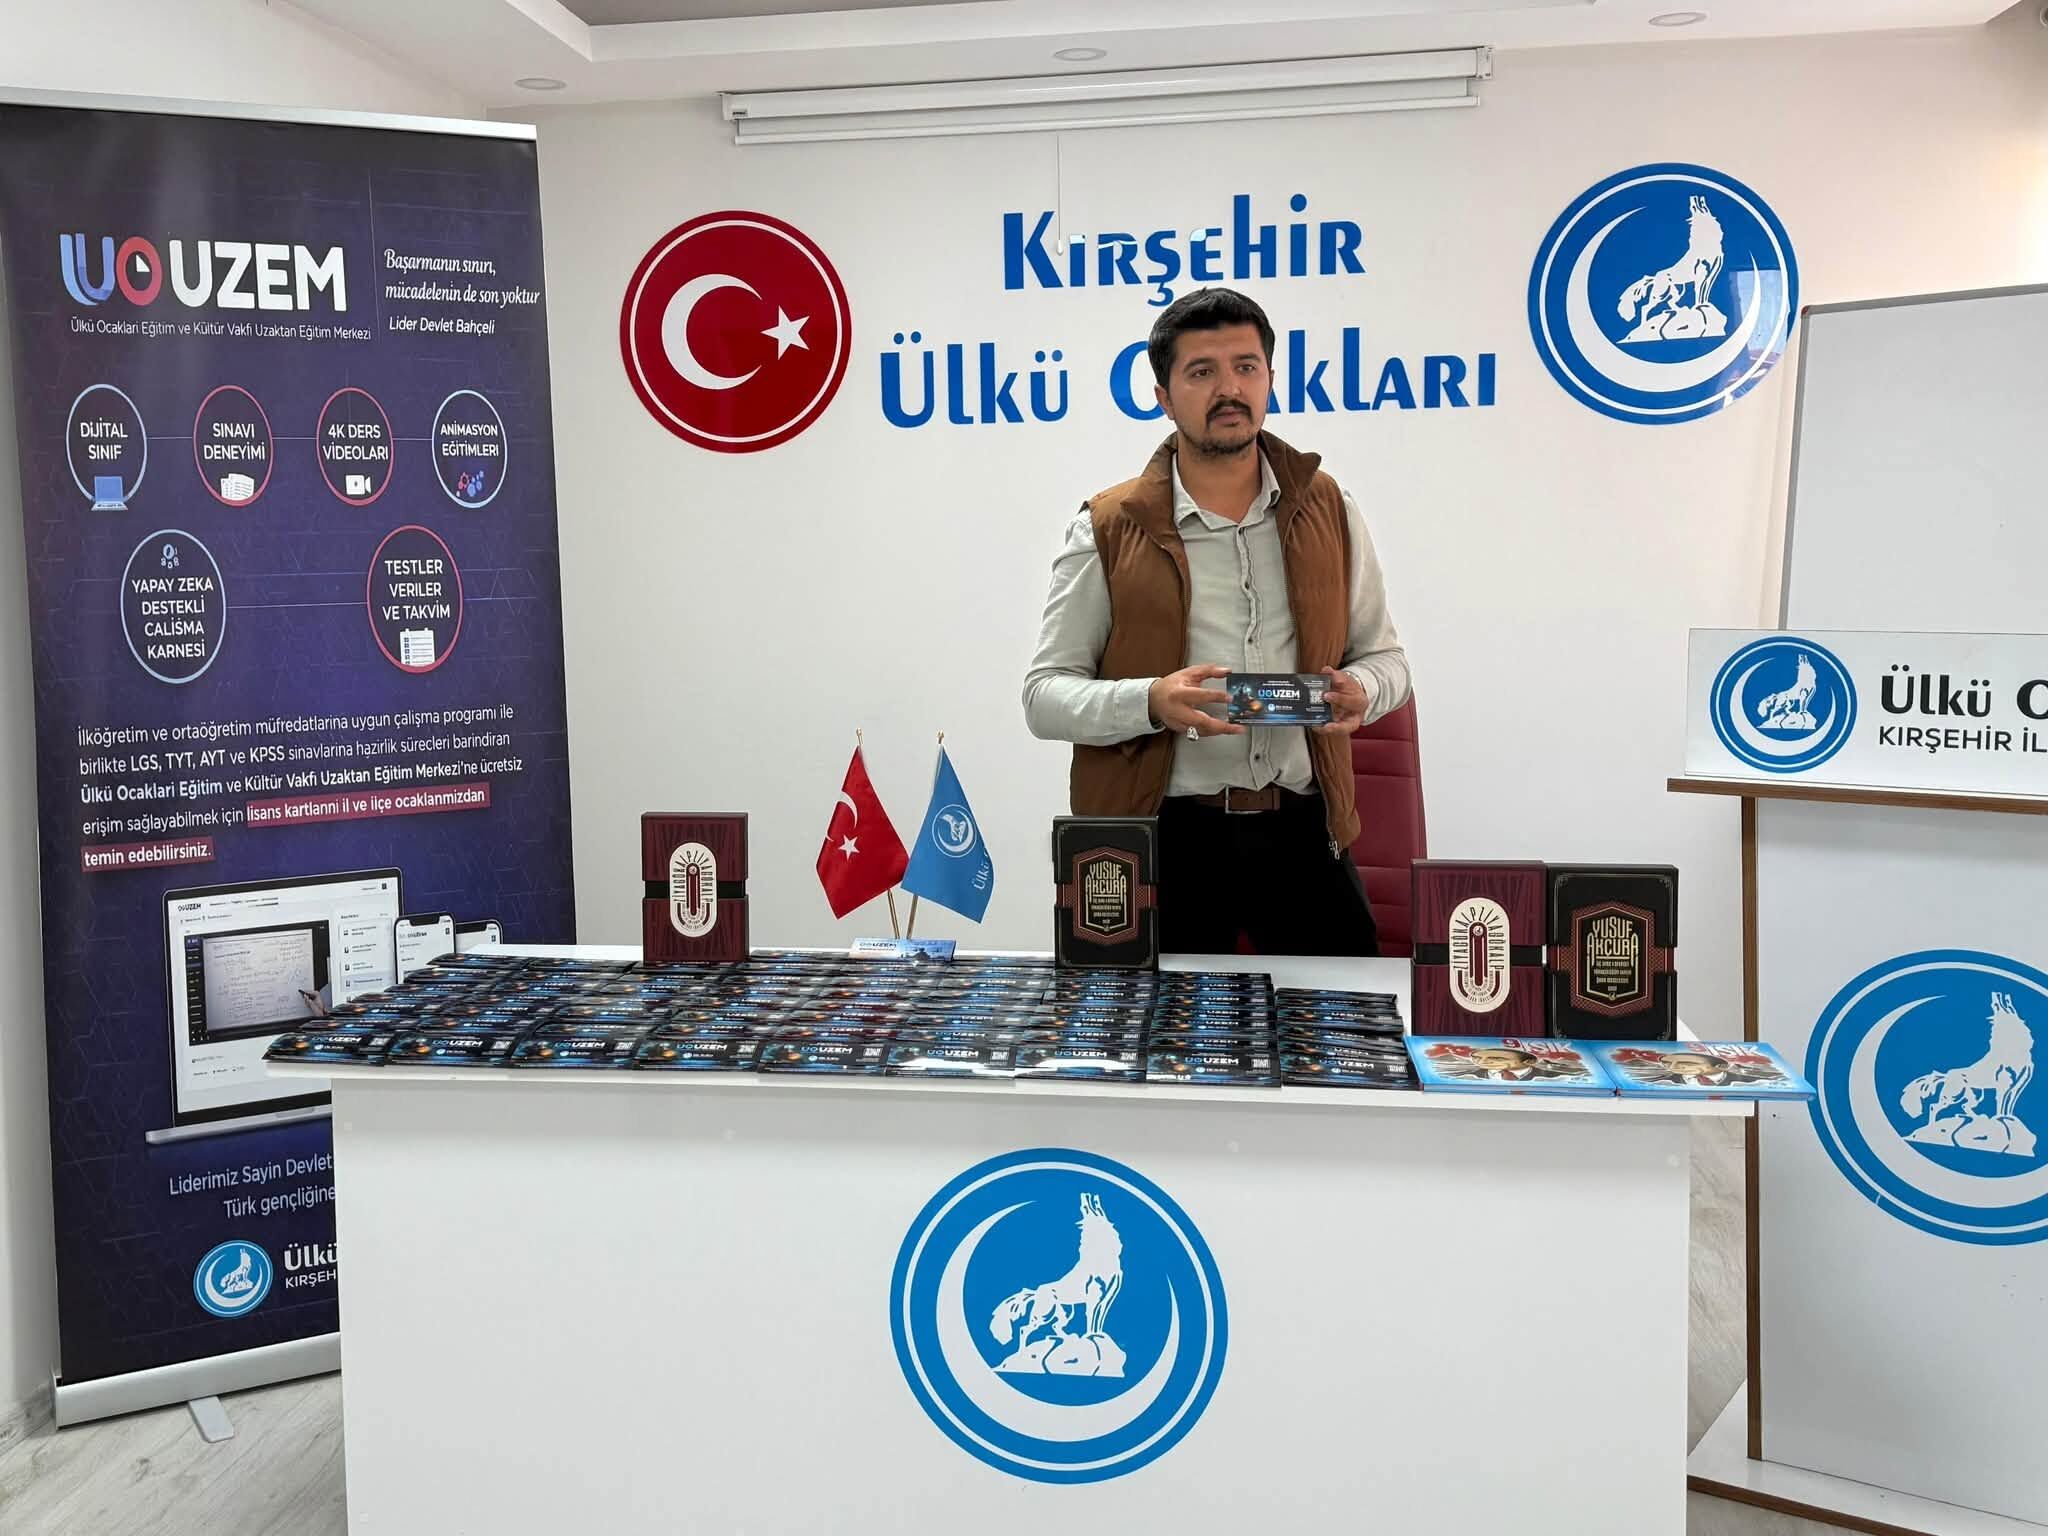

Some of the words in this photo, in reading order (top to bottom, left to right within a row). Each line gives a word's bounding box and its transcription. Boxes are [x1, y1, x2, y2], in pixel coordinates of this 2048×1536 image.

[384, 248, 460, 274] Başarmanın
[385, 280, 460, 302] mücadelenin
[463, 283, 477, 302] de
[479, 291, 499, 303] son
[500, 286, 540, 308] yoktur
[178, 323, 191, 335] ve
[255, 323, 296, 338] Uzaktan
[334, 326, 371, 340] Merkezi
[389, 315, 417, 331] Lider
[420, 316, 454, 333] Devlet
[456, 319, 495, 336] Bahçeli
[880, 331, 1069, 428] Ülkü
[212, 422, 255, 438] SINAVI
[328, 424, 345, 439] 4K
[349, 424, 381, 439] DERS
[440, 420, 498, 436] ANİMASYON
[88, 444, 122, 460] SINIF
[203, 441, 266, 460] DENEYİMİ
[384, 559, 443, 575] TESTLER
[132, 578, 174, 593] YAPAY
[177, 577, 214, 592] ZEKA
[142, 594, 205, 615] DESTEKLİ
[382, 605, 400, 620] VE
[402, 600, 450, 620] TAKVİM
[147, 638, 205, 659] KARNESİ
[1881, 663, 1991, 718] Ülkü
[152, 728, 168, 741] ve
[172, 721, 251, 741] ortaöğretim
[351, 713, 391, 731] uygun
[499, 704, 514, 720] ile
[1879, 724, 2012, 753] KIRŞEHİR
[80, 757, 127, 776] birlikte
[131, 754, 162, 772] LGS,
[165, 752, 196, 770] TYT,
[200, 749, 226, 766] AYT
[229, 751, 246, 765] ve
[250, 746, 285, 763] KPSS
[81, 784, 112, 804] Ülkü
[179, 779, 223, 799] Eğitim
[226, 780, 241, 793] ve
[245, 774, 283, 792] Kültür
[321, 769, 370, 786] Uzaktan
[374, 766, 413, 784] Eğitim
[416, 761, 478, 779] Merkezi'ne
[480, 756, 523, 773] ücretsiz
[83, 818, 123, 836] erişim
[127, 809, 219, 834] sağlayabilmek
[221, 808, 243, 827] için
[247, 805, 281, 821] lisans
[342, 798, 350, 812] il
[352, 800, 367, 812] ve
[371, 796, 392, 813] ilçe
[84, 849, 124, 867] temin
[128, 843, 212, 864] edebilirsiniz.
[1089, 861, 1122, 880] YUSUF
[1592, 916, 1633, 939] YUSUF
[169, 1168, 239, 1195] Liderimiz
[286, 1153, 333, 1177] Devlet
[224, 1198, 257, 1219] Türk
[261, 1185, 337, 1216] gençliğine
[284, 1242, 338, 1271] Ülkü
